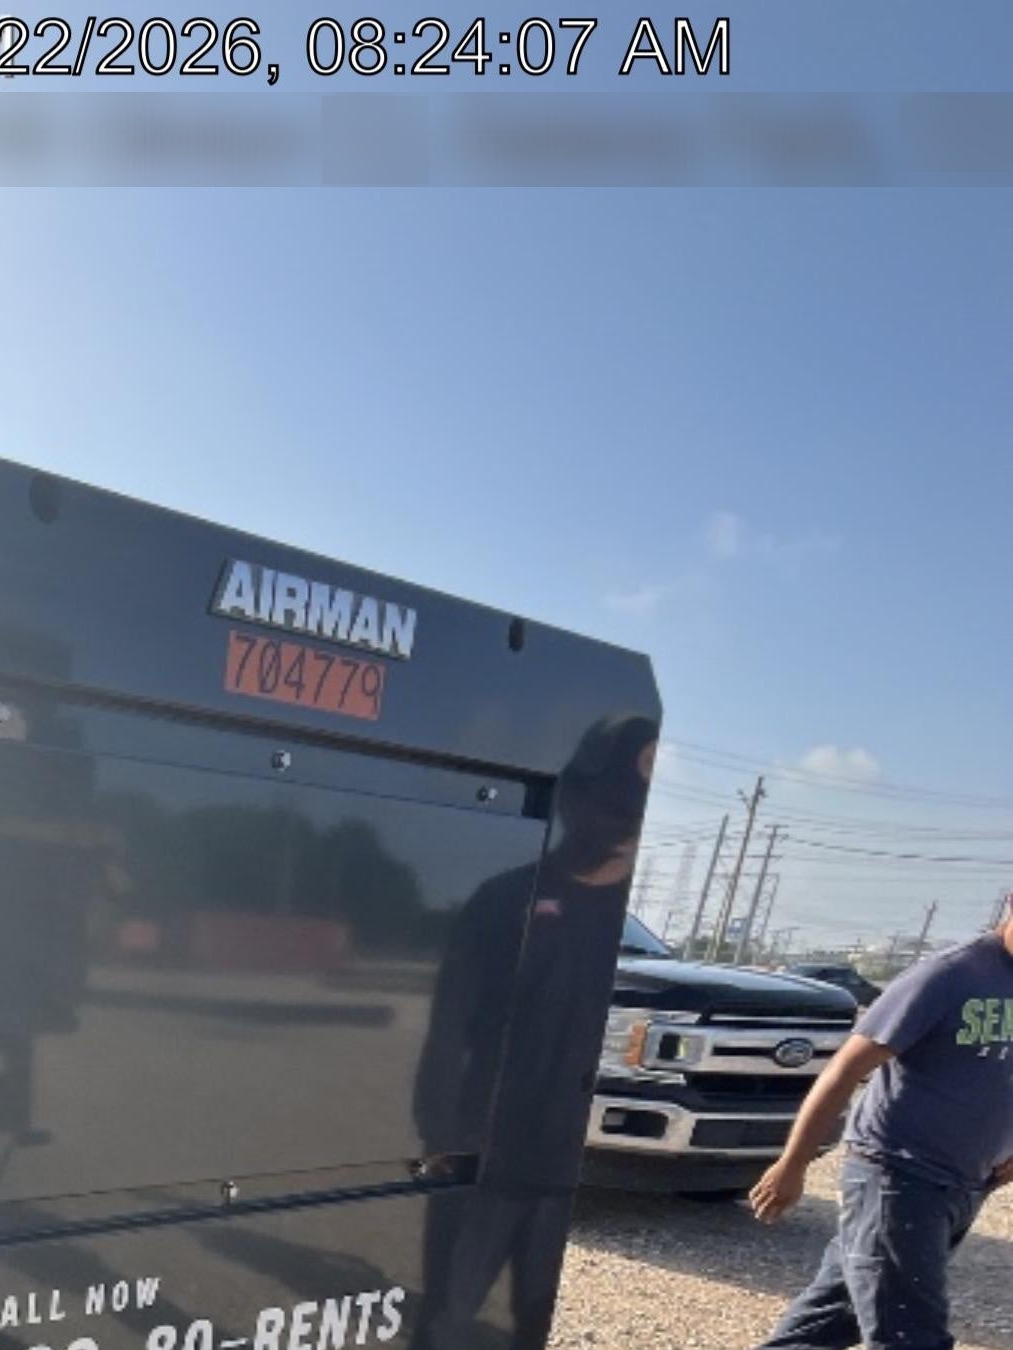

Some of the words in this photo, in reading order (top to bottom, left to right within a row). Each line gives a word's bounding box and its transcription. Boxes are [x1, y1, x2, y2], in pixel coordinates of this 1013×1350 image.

[219, 560, 417, 658] AIRMAN
[234, 634, 381, 714] 704779
[85, 1277, 160, 1315] NOW
